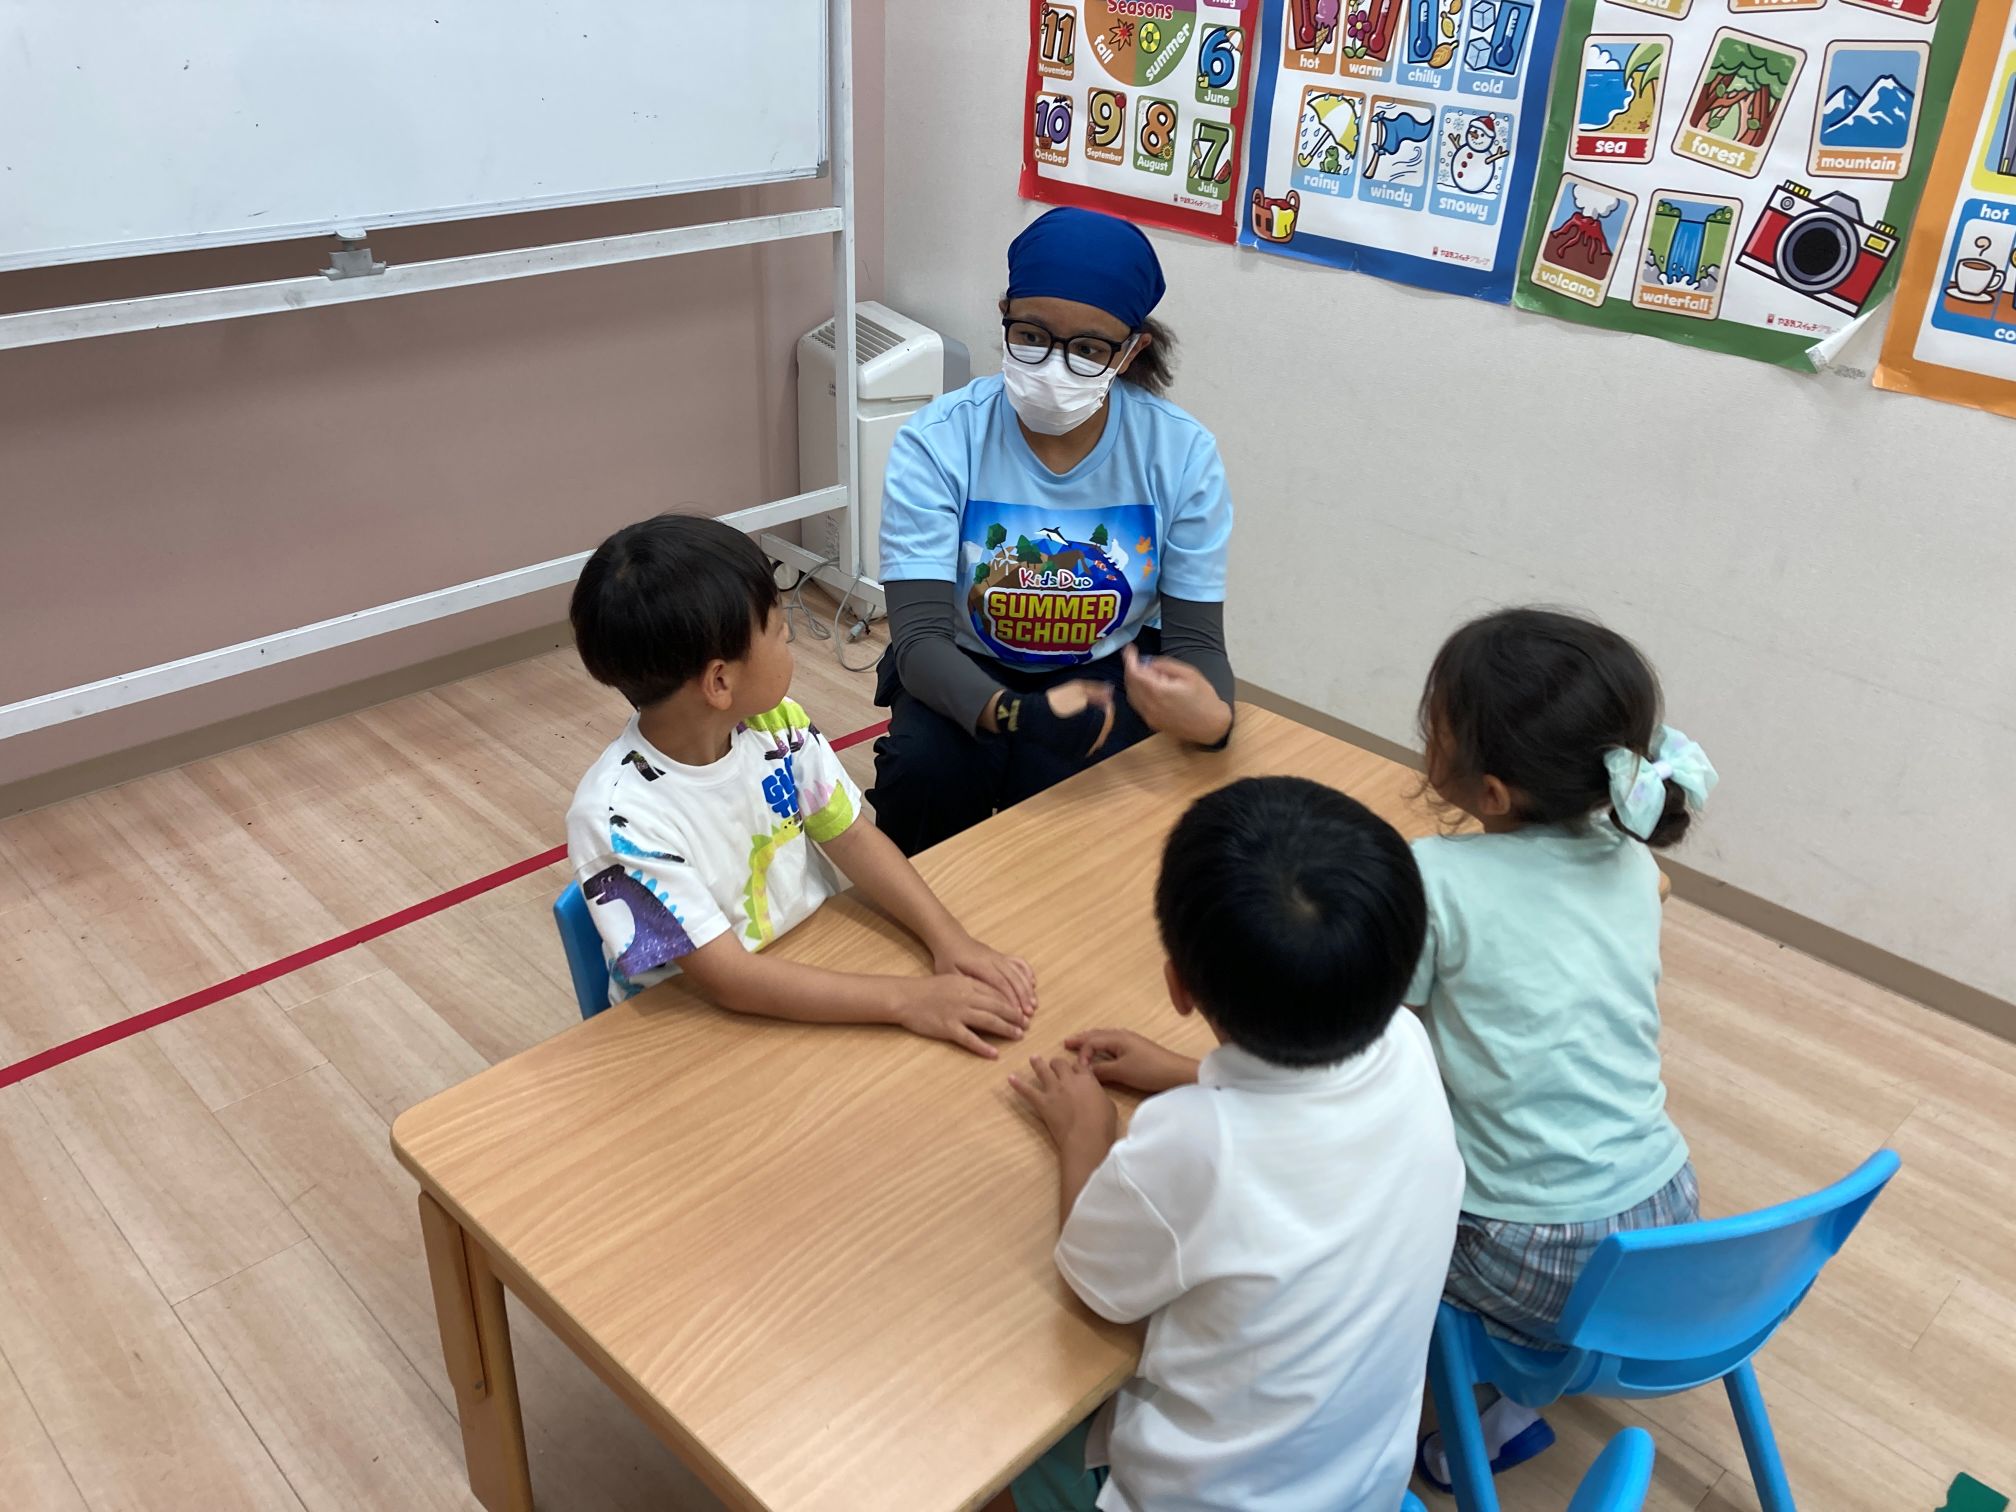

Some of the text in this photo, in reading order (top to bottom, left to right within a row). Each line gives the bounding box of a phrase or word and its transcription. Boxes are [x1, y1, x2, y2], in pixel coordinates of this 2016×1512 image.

[1107, 0, 1174, 21] Seasons
[1042, 9, 1074, 64] 11
[1093, 34, 1115, 64] fall
[1144, 23, 1191, 82] summer
[1199, 27, 1235, 89] 6
[1038, 63, 1073, 78] November
[1299, 55, 1321, 70] hot
[1348, 63, 1384, 78] warm
[1407, 69, 1442, 89] chilly
[1472, 79, 1504, 95] cold
[1204, 90, 1231, 105] June
[1035, 100, 1071, 144] 10
[1090, 91, 1123, 147] 9
[1140, 101, 1176, 158] 8
[1034, 149, 1067, 165] October
[1086, 147, 1123, 163] September
[1198, 123, 1230, 181] 7
[1594, 138, 1628, 155] sea
[1688, 135, 1747, 168] forest
[1136, 157, 1169, 173] August
[1820, 154, 1897, 172] mountain
[1197, 181, 1219, 198] July
[1303, 173, 1341, 195] rainy
[1370, 185, 1413, 208] windy
[1438, 196, 1489, 219] snowy
[1980, 203, 2010, 221] hot
[1541, 268, 1597, 299] volcano
[1642, 290, 1710, 313] waterfall
[989, 593, 1115, 620] SUMMER
[999, 620, 1098, 644] SCHOOL
